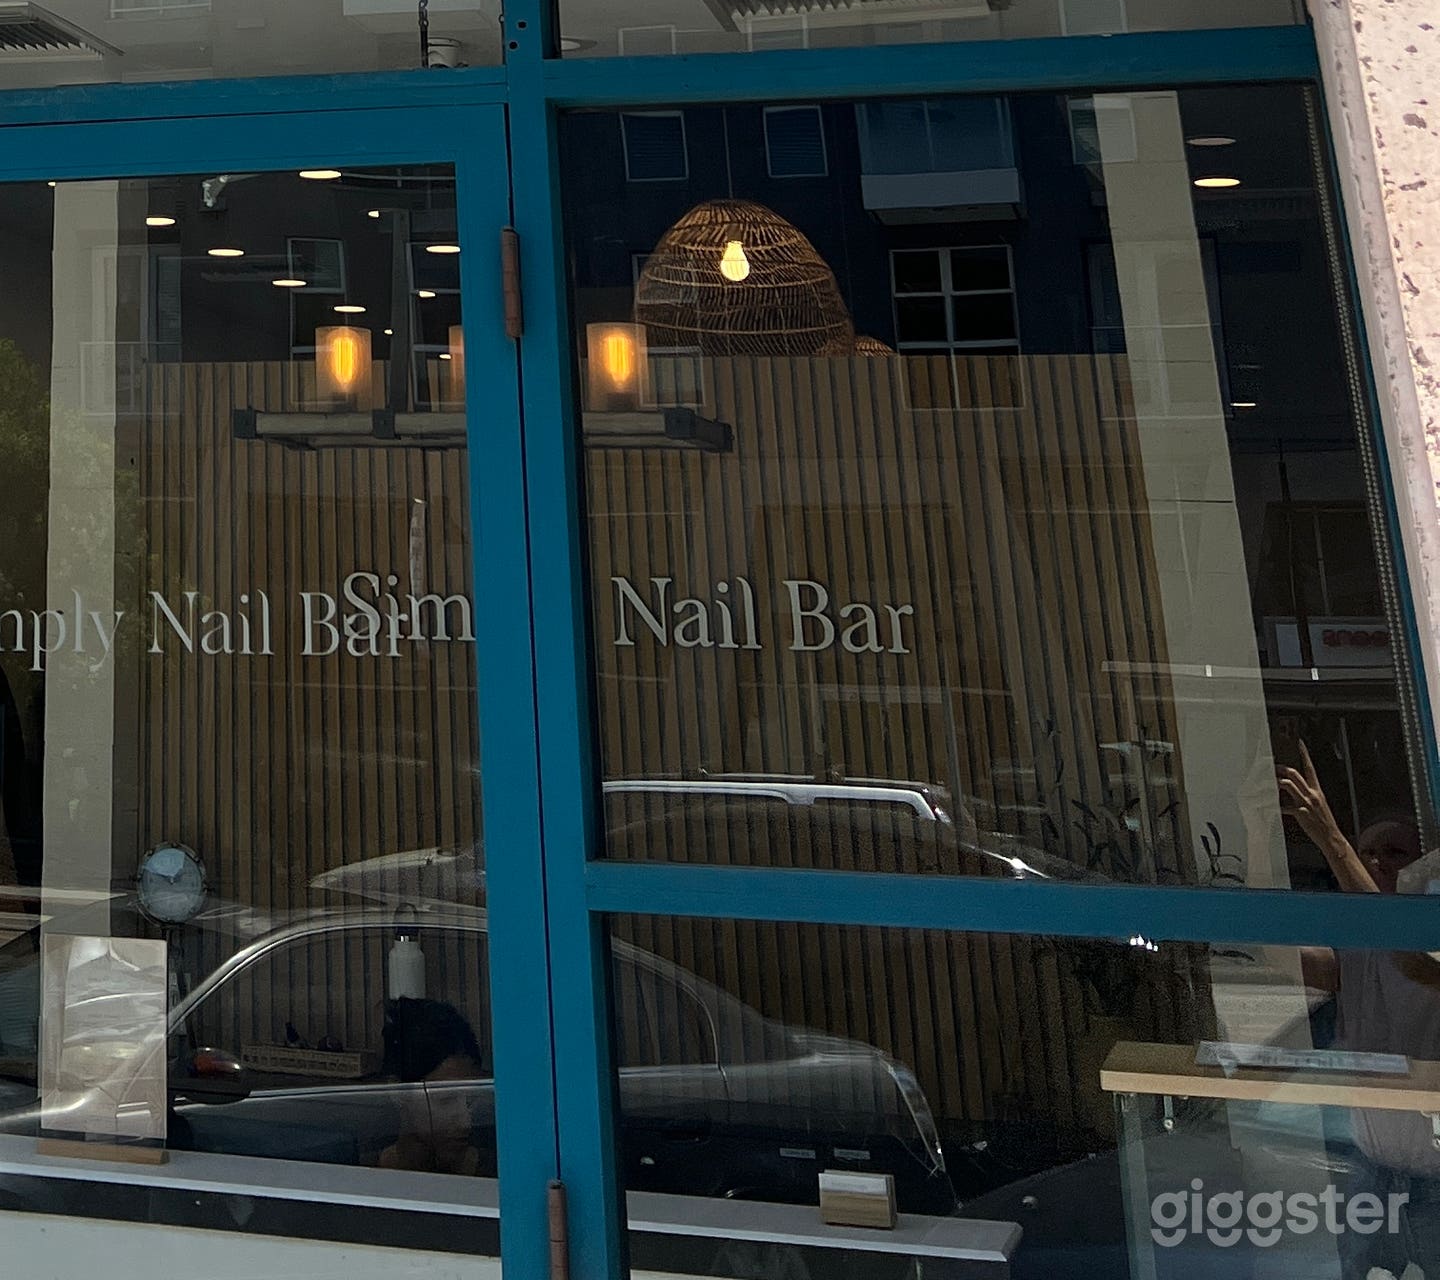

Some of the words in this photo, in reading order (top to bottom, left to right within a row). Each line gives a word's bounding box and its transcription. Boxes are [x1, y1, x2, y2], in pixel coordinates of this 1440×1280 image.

[148, 589, 275, 657] Nail
[298, 591, 409, 658] Bar
[343, 571, 477, 642] Sim
[610, 576, 762, 650] Nail
[782, 579, 915, 654] Bar
